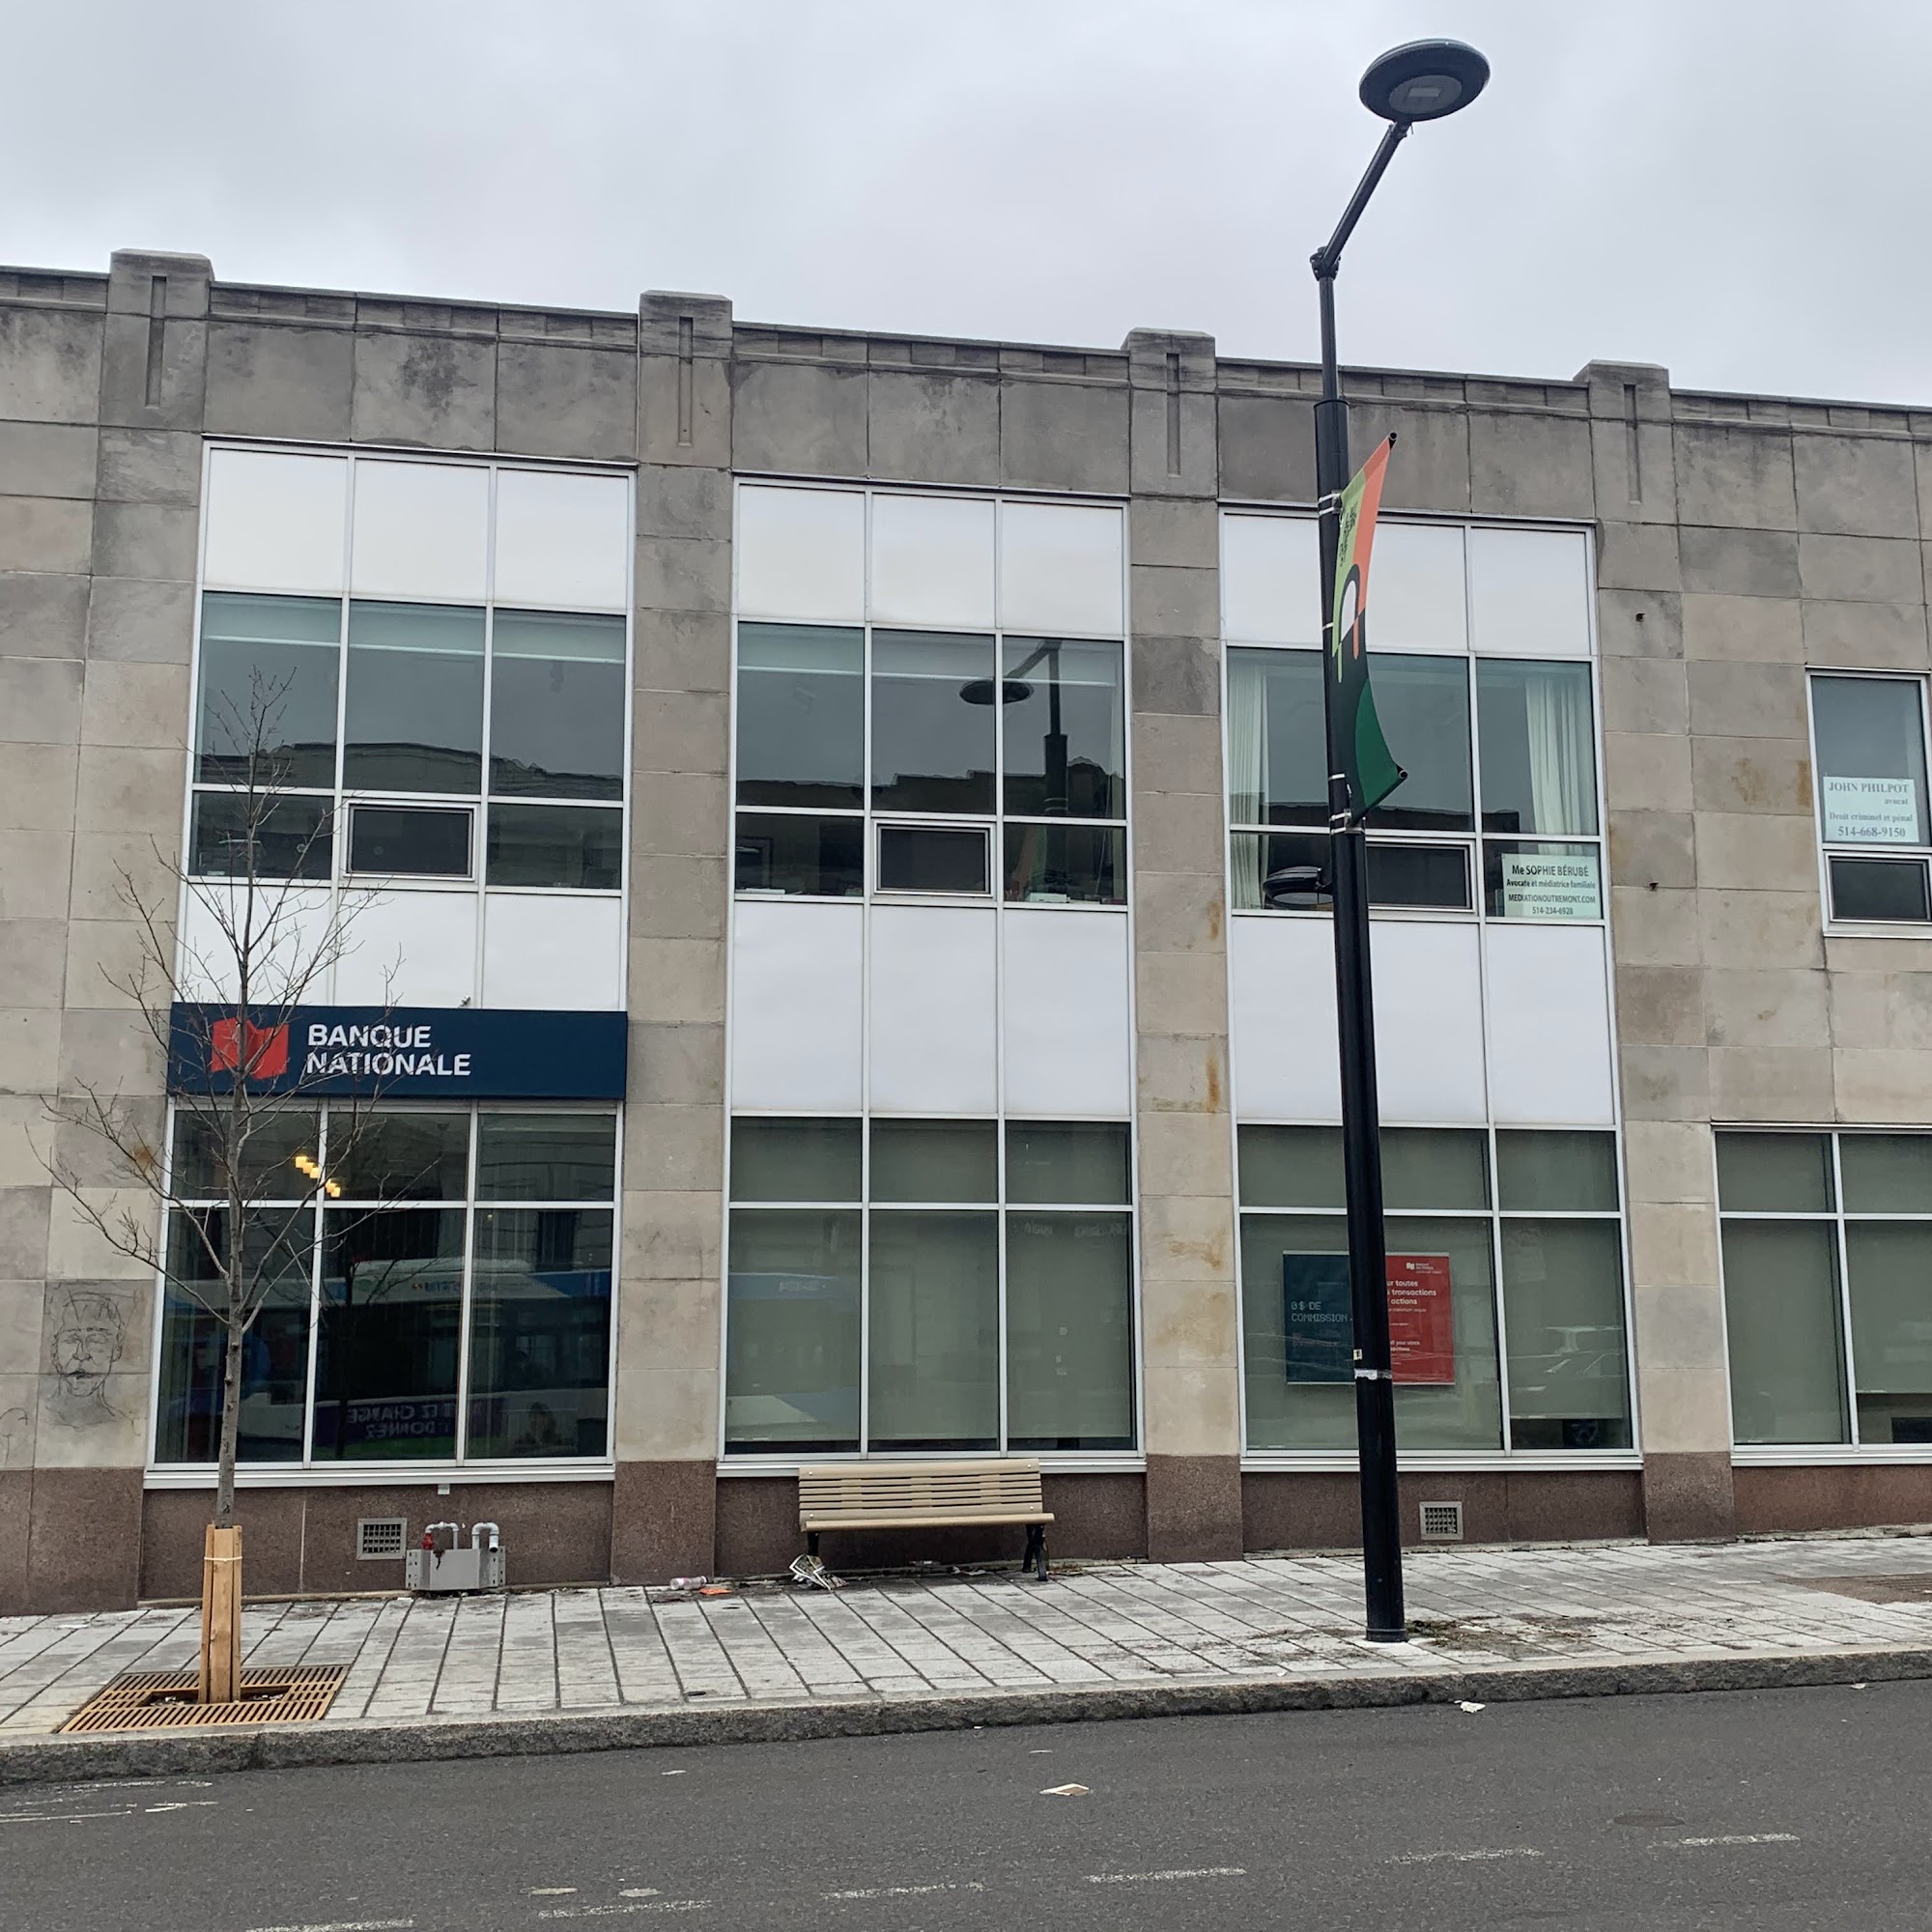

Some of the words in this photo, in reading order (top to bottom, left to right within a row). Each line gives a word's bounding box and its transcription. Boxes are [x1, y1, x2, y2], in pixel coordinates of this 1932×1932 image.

[1829, 782, 1858, 791] JOHN
[1861, 783, 1909, 792] PHILPOT
[1838, 827, 1906, 837] 514-668-9150
[1512, 865, 1524, 875] Me
[1526, 866, 1555, 875] SOPHIE
[1558, 865, 1589, 876] BÉRUBÉ
[1539, 879, 1569, 888] médiatrice
[1571, 880, 1596, 889] familiale
[1508, 895, 1596, 903] MEDIATIONOUTREMONT.COM
[307, 1024, 432, 1048] BANQUE
[305, 1052, 471, 1076] NATIONALE
[1308, 1301, 1321, 1311] DE
[1291, 1313, 1348, 1322] COMMISSION
